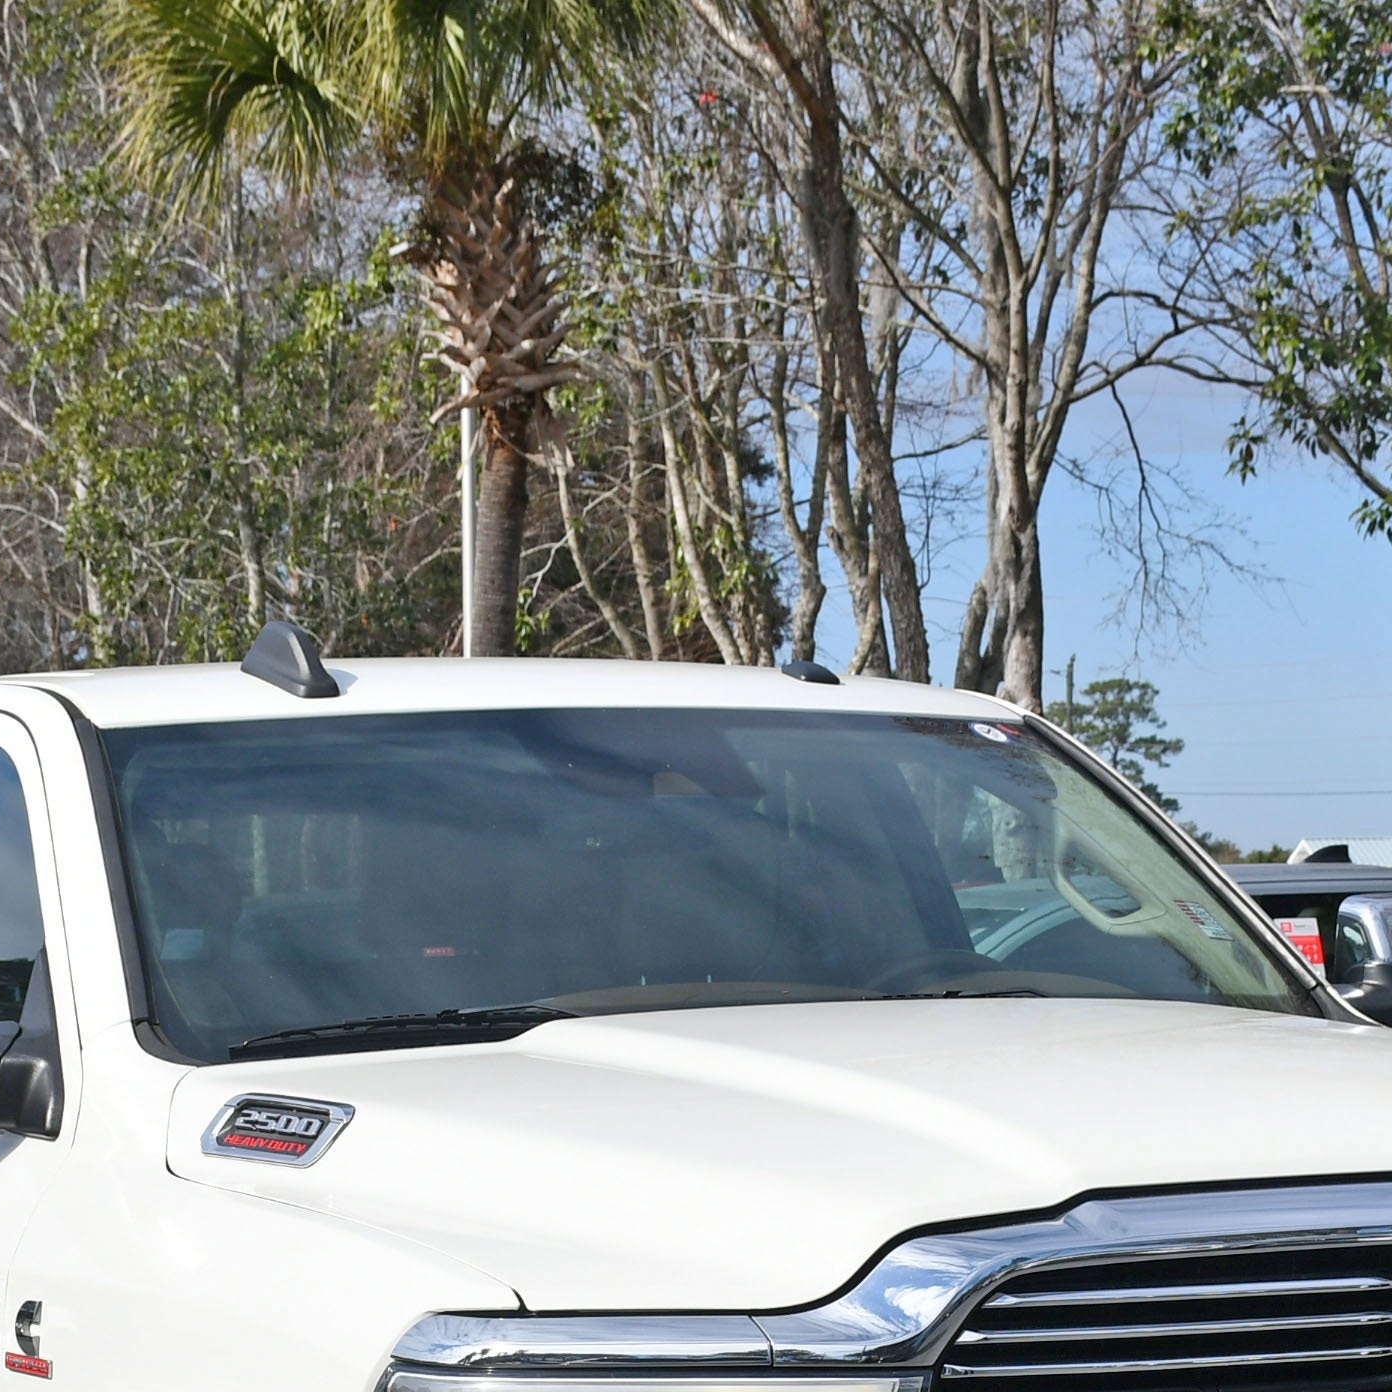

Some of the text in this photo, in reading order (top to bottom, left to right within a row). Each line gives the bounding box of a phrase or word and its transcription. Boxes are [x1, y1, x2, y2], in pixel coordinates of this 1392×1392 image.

[235, 1109, 323, 1137] 2500
[224, 1133, 308, 1154] HEAVY DUTY
